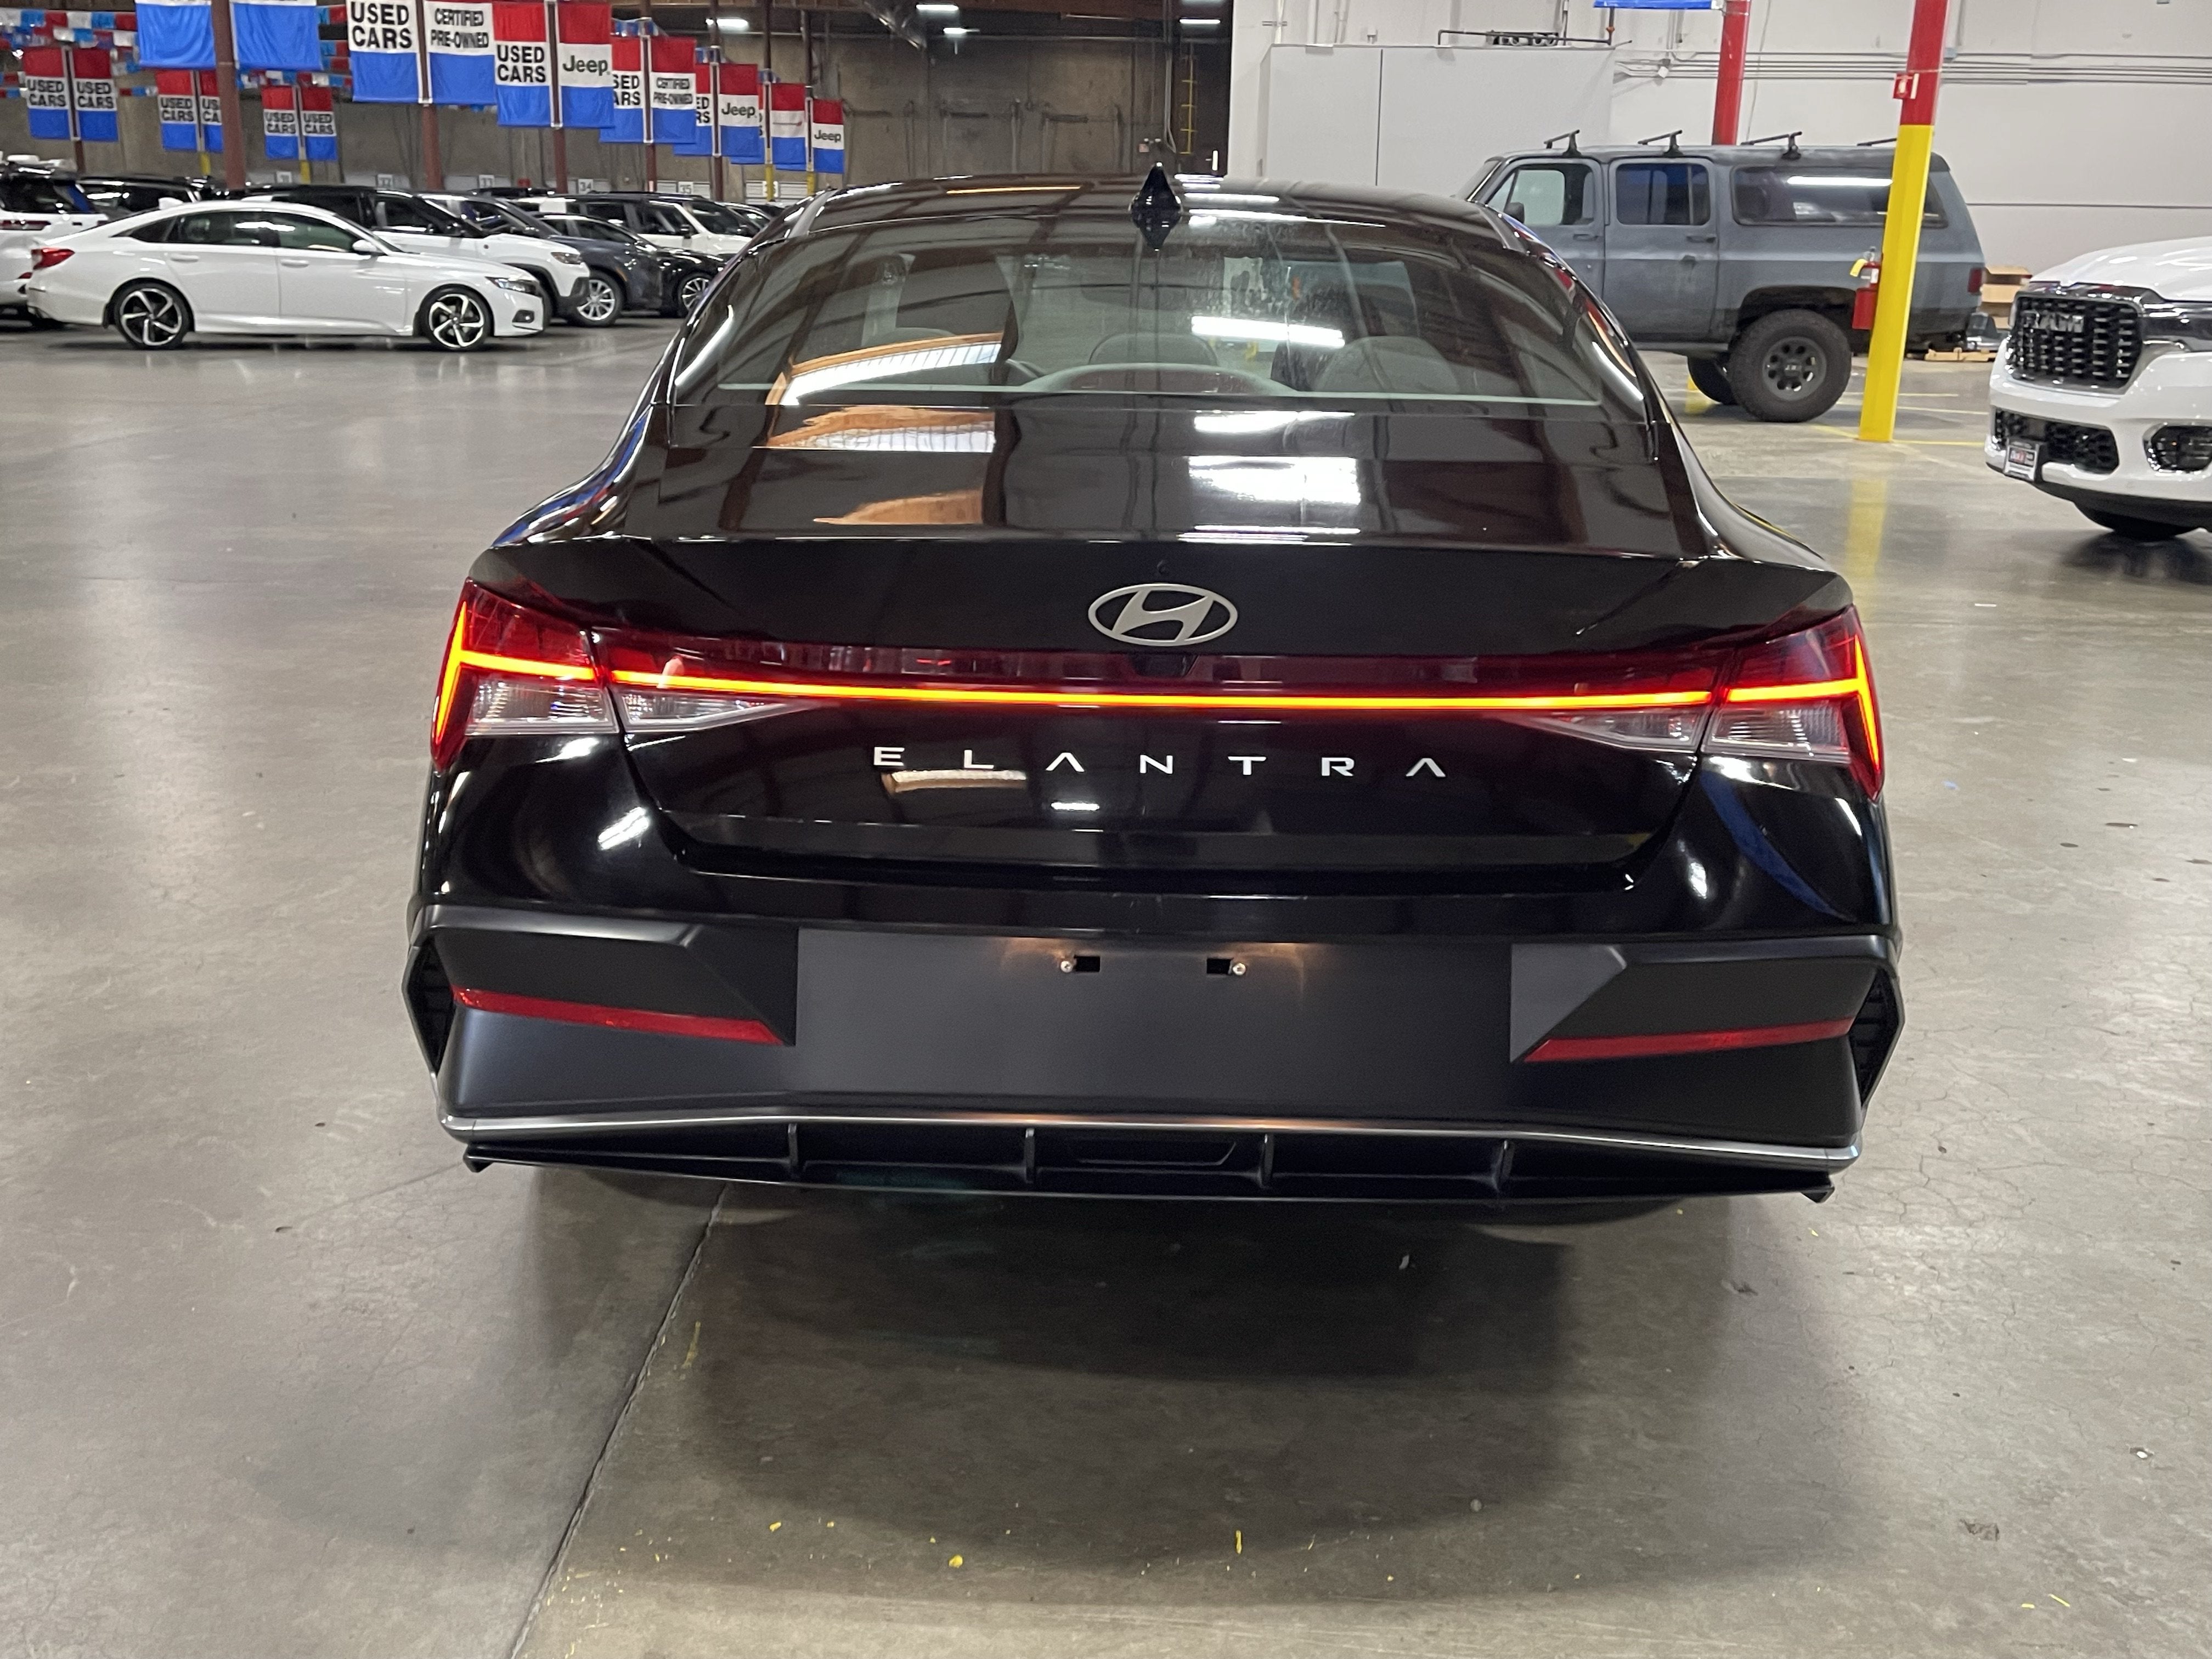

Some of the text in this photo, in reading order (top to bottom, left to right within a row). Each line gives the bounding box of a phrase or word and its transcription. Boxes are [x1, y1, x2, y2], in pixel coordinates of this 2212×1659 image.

[351, 2, 409, 25] USED
[435, 8, 484, 26] CERTIFIED
[352, 25, 412, 49] CARS
[431, 29, 489, 48] PRE-OWNED
[497, 44, 545, 63] USED
[562, 55, 608, 76] Jeep
[498, 64, 546, 82] CARS
[27, 79, 64, 93] USED
[77, 82, 112, 94] USED
[613, 74, 640, 89] SED
[29, 94, 66, 106] CARS
[77, 96, 114, 109] CARS
[160, 97, 193, 109] USED
[202, 98, 219, 110] US
[613, 91, 641, 105] ARS
[161, 110, 194, 122] CARS
[202, 111, 220, 122] CA
[266, 112, 295, 122] USED
[696, 111, 710, 123] RS
[721, 103, 755, 118] Jeep
[304, 113, 332, 123] USED
[267, 123, 296, 134] CARS
[304, 124, 334, 134] CARS
[814, 129, 842, 143] Jeep
[873, 747, 1446, 778] ELANTRA
